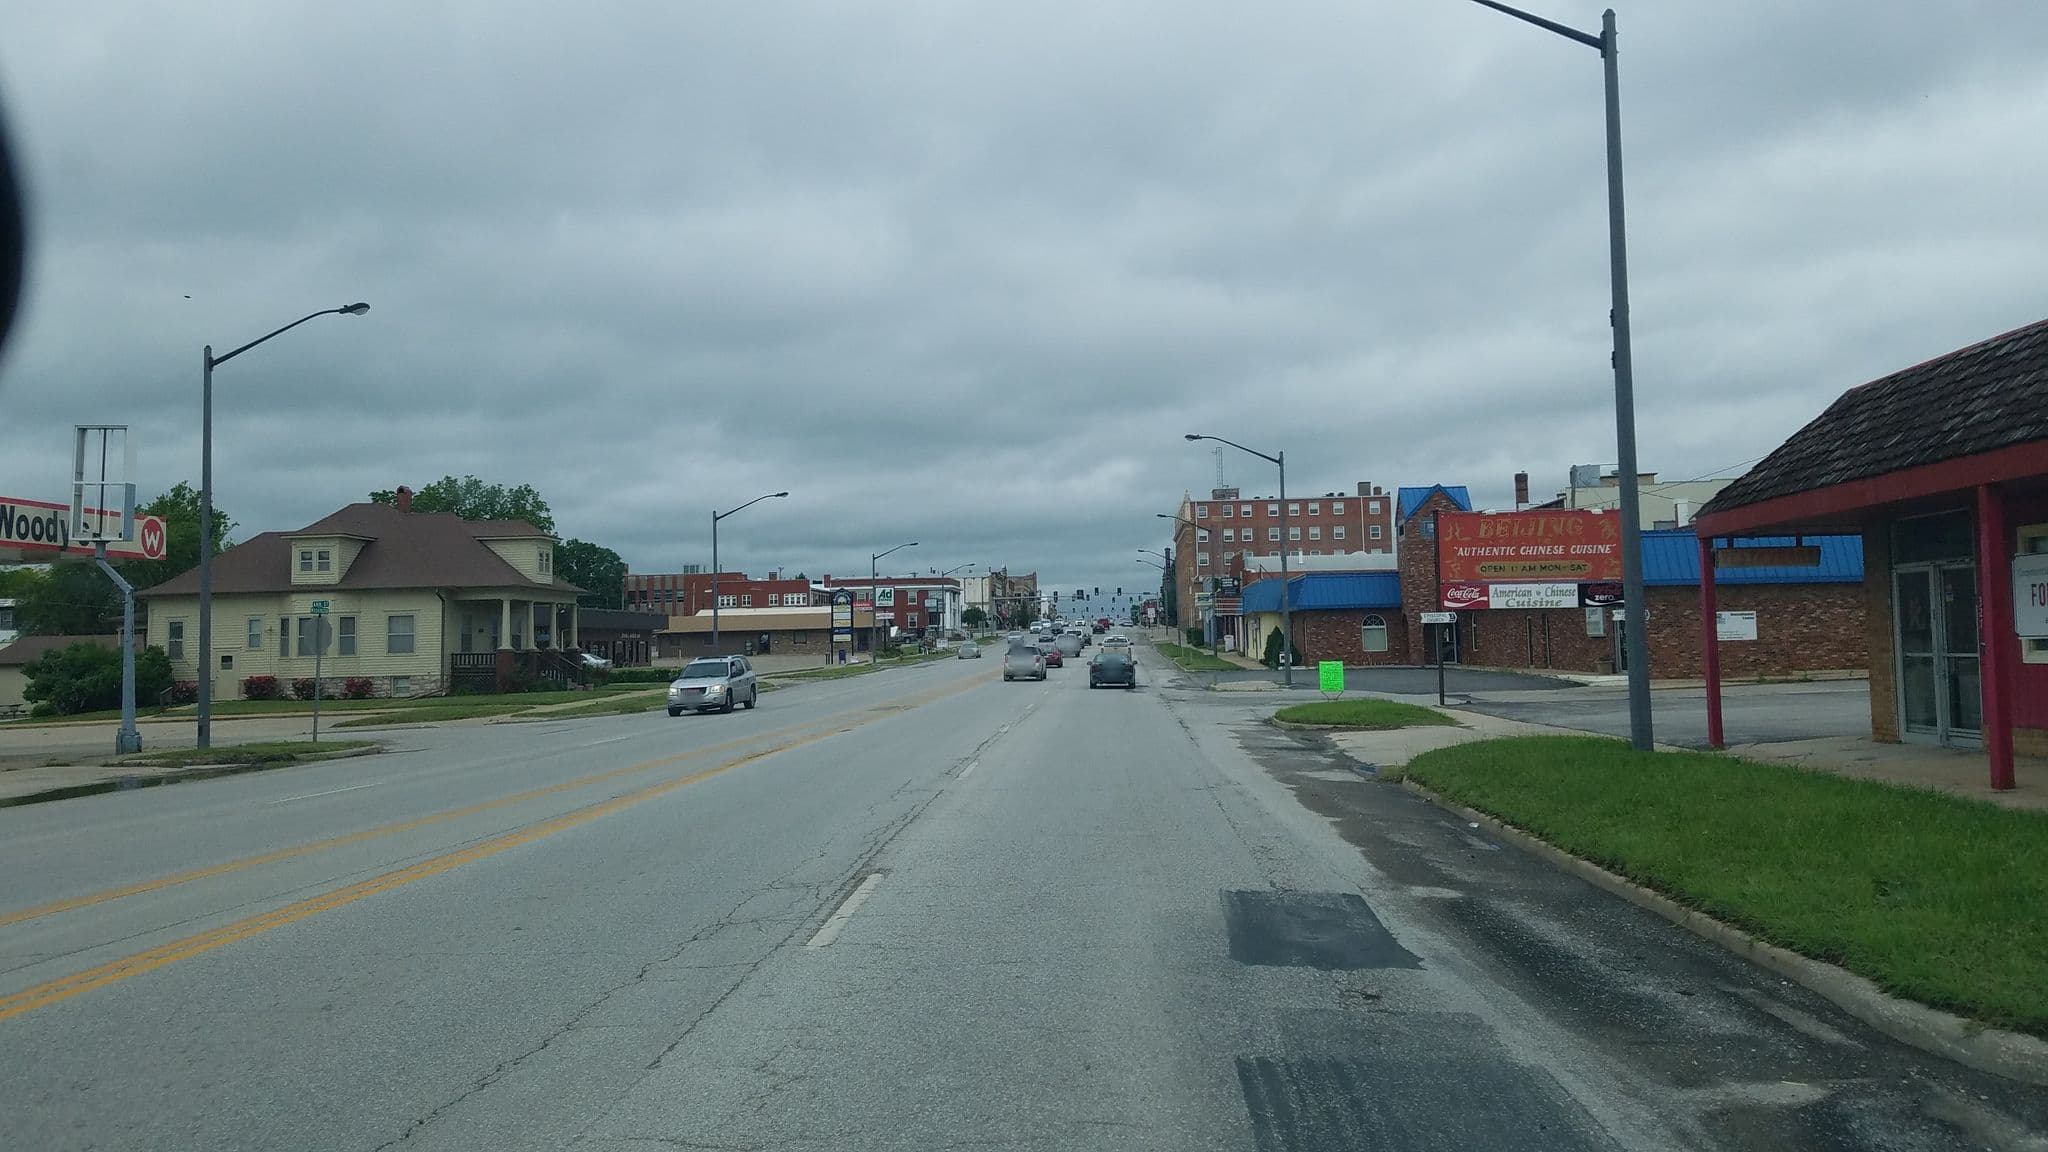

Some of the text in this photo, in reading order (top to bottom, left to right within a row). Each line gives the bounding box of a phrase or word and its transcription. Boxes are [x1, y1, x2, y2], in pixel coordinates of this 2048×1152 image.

[1479, 516, 1584, 538] BEIJING
[144, 529, 161, 552] W
[1519, 545, 1566, 556] CHINESE
[1480, 565, 1506, 573] OPEN
[1521, 564, 1537, 572] AM
[1447, 588, 1481, 599] Coca-Cola
[1491, 585, 1577, 598] American Chinese
[2031, 582, 2048, 607] FO
[1504, 597, 1563, 608] Cuisine
